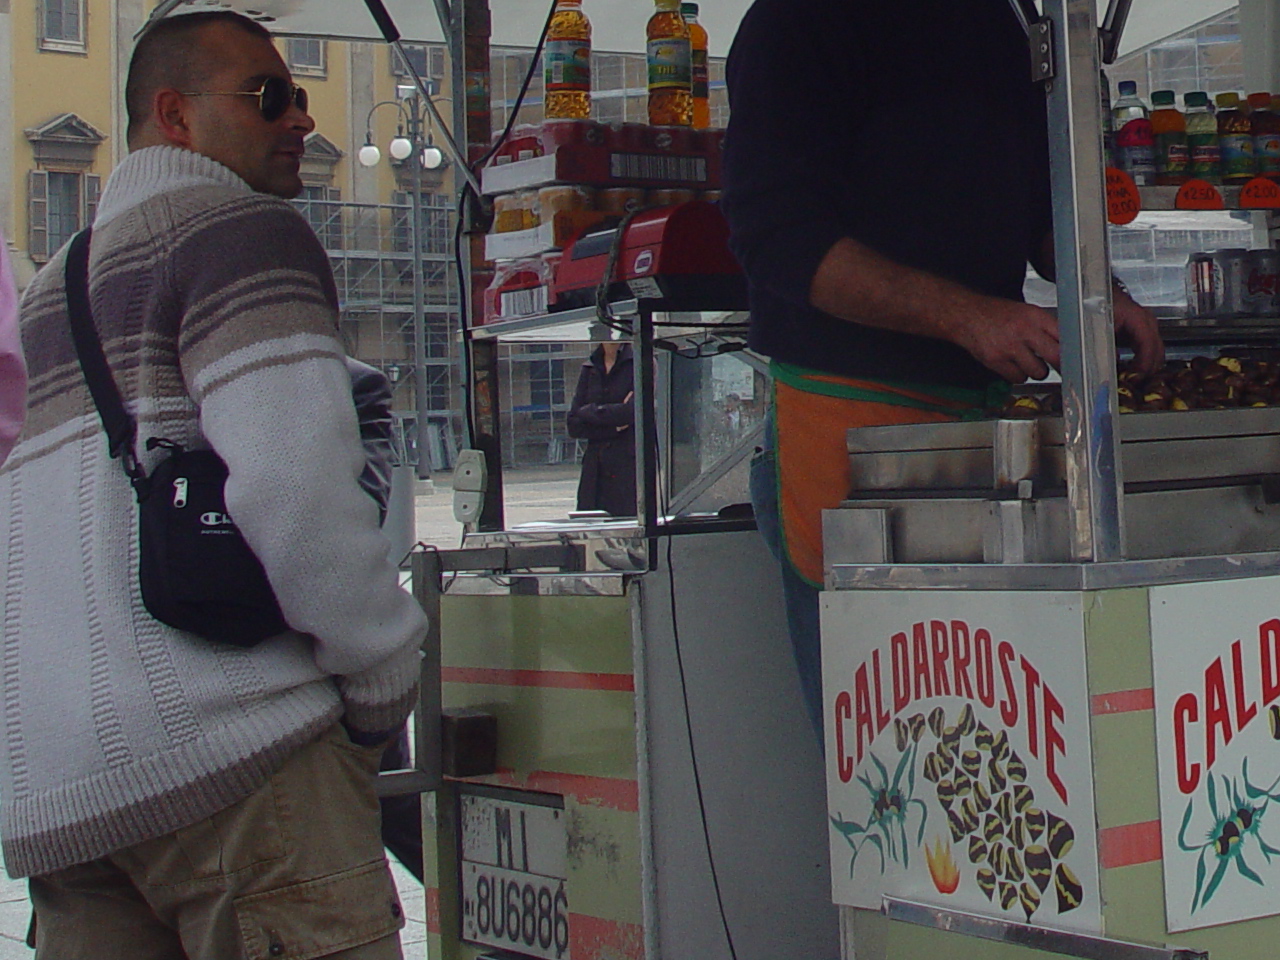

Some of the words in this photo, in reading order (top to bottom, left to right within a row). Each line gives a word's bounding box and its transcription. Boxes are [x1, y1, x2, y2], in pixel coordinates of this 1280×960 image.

[836, 619, 1069, 807] CALDARROSTE
[496, 807, 529, 873] MI
[477, 875, 569, 953] 8U6886
